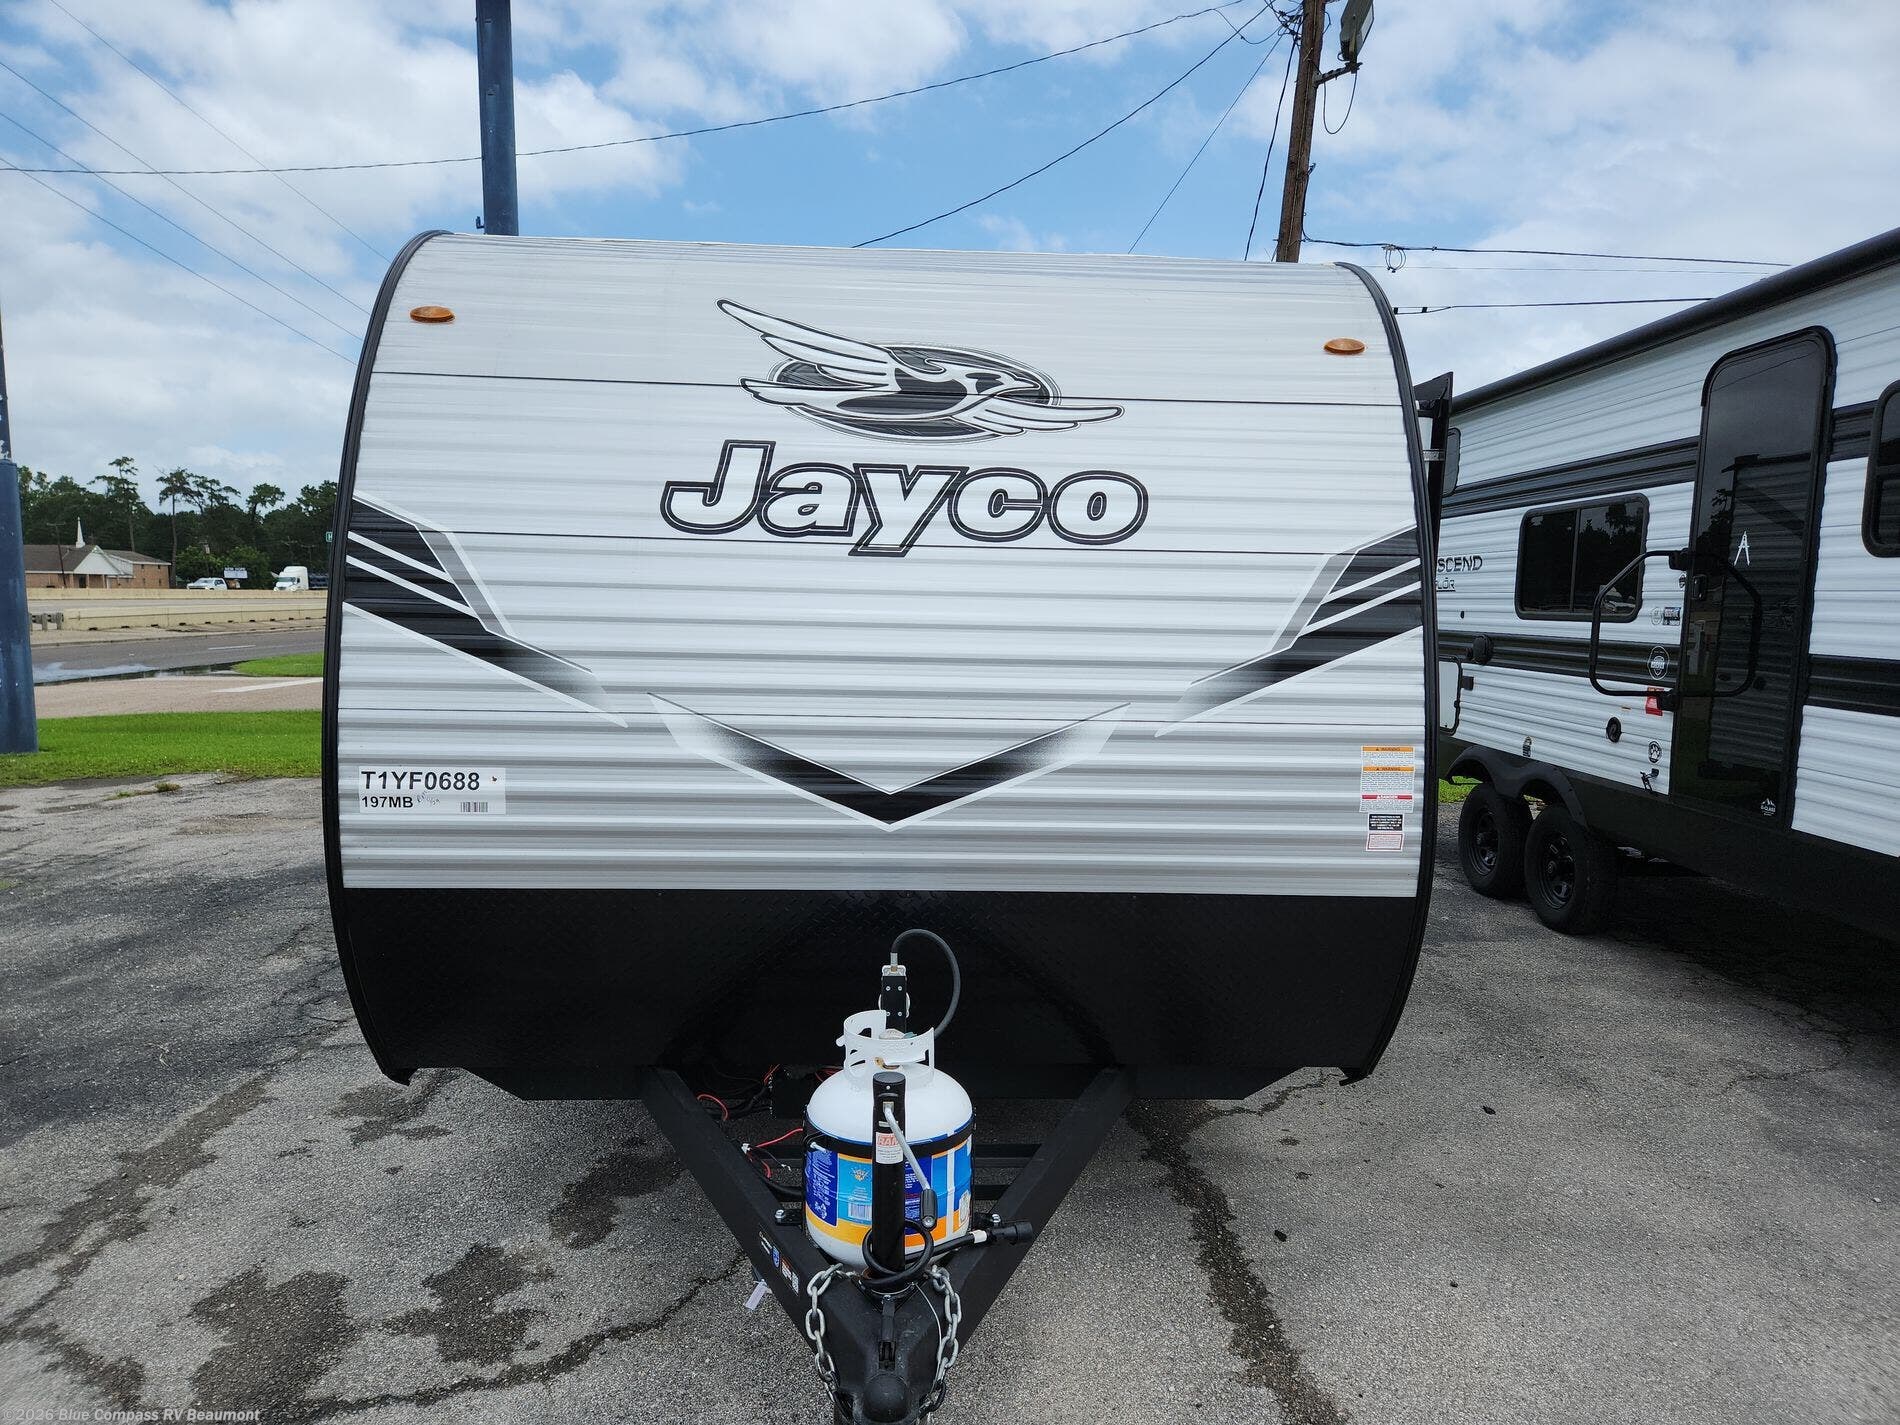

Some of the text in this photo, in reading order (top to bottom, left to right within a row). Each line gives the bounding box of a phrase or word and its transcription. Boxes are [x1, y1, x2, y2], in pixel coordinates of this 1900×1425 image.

[660, 439, 1149, 558] Jayco
[1437, 555, 1483, 573] SCEND
[361, 771, 480, 791] T1YF0688
[361, 796, 413, 808] 197MB
